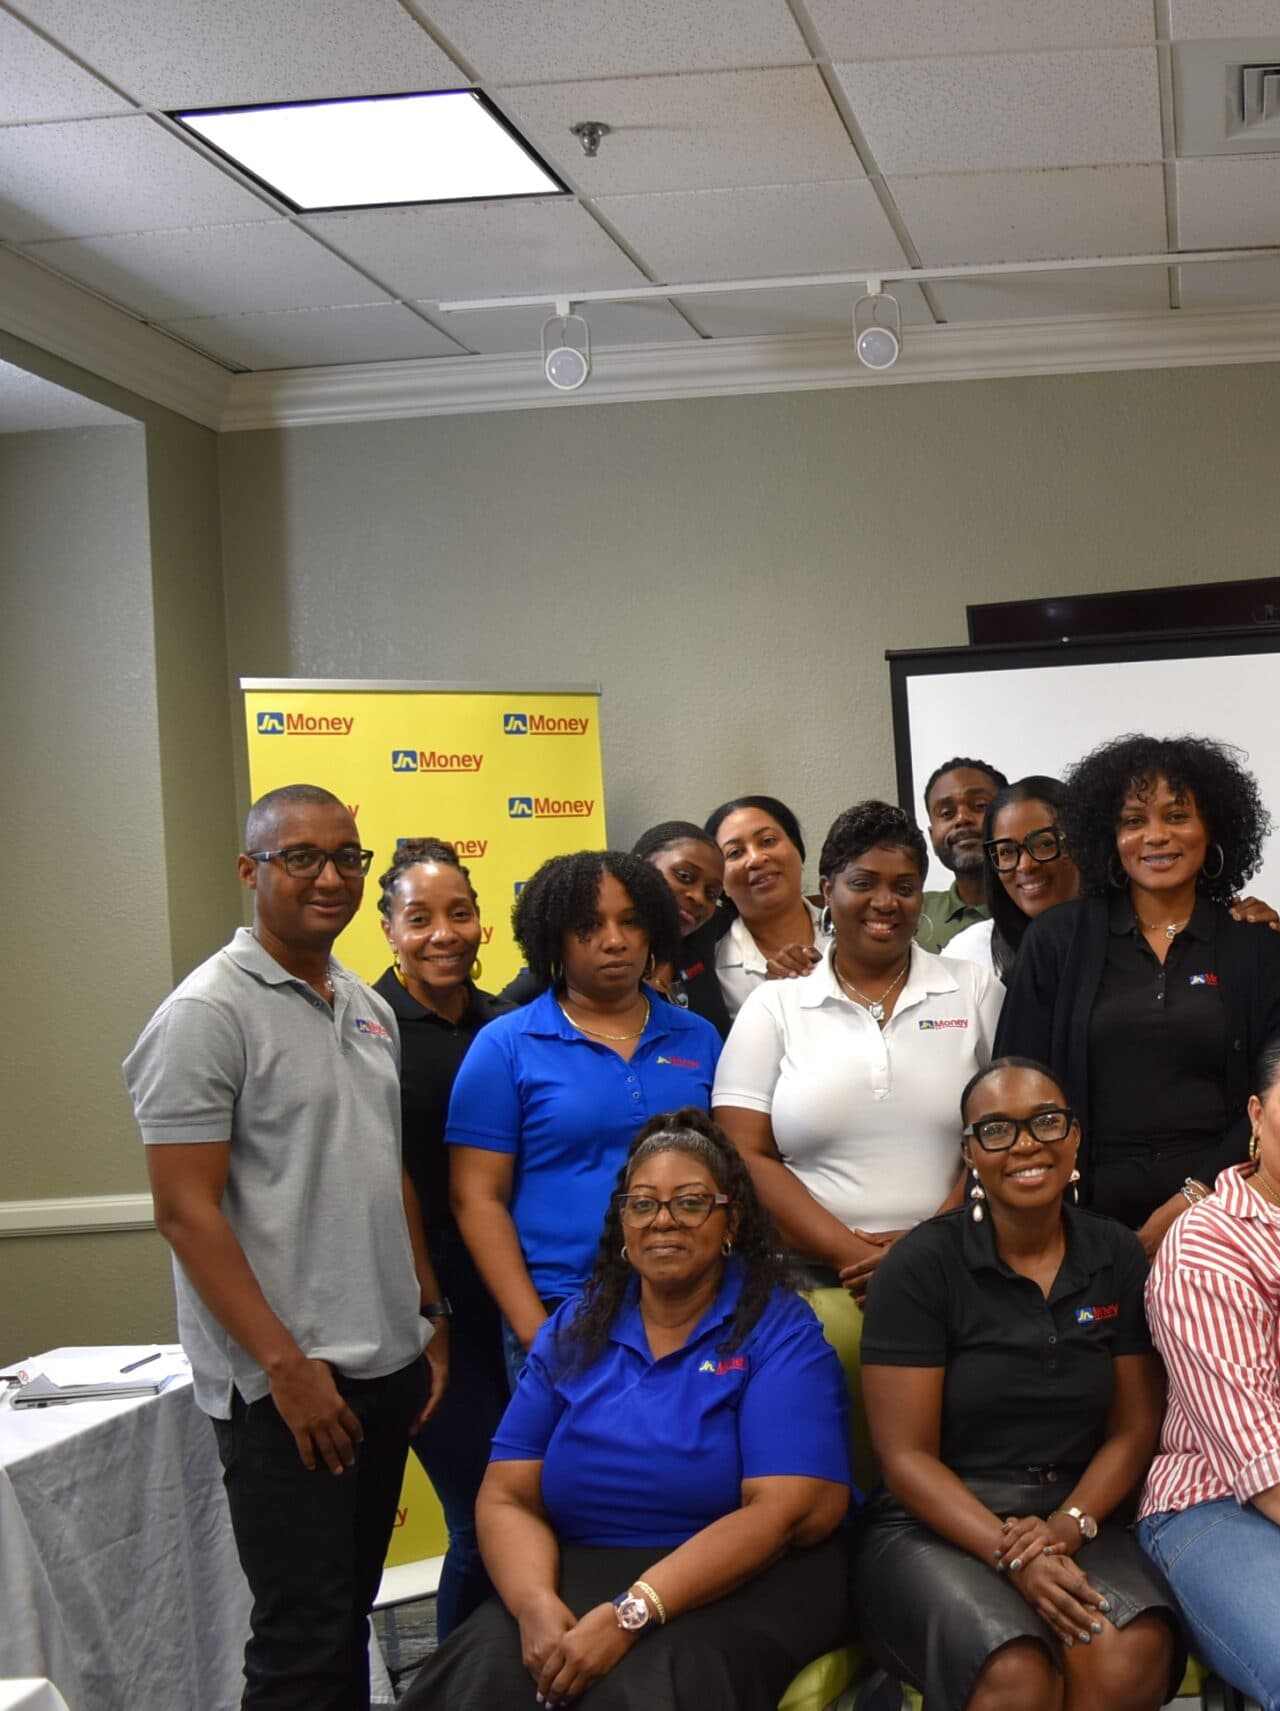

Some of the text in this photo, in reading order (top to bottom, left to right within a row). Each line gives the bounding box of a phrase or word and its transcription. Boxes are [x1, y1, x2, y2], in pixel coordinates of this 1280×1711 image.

[286, 713, 354, 735] Money
[529, 715, 589, 735] Money
[419, 751, 484, 772] Money
[534, 797, 595, 818] Money
[449, 840, 488, 858] ney
